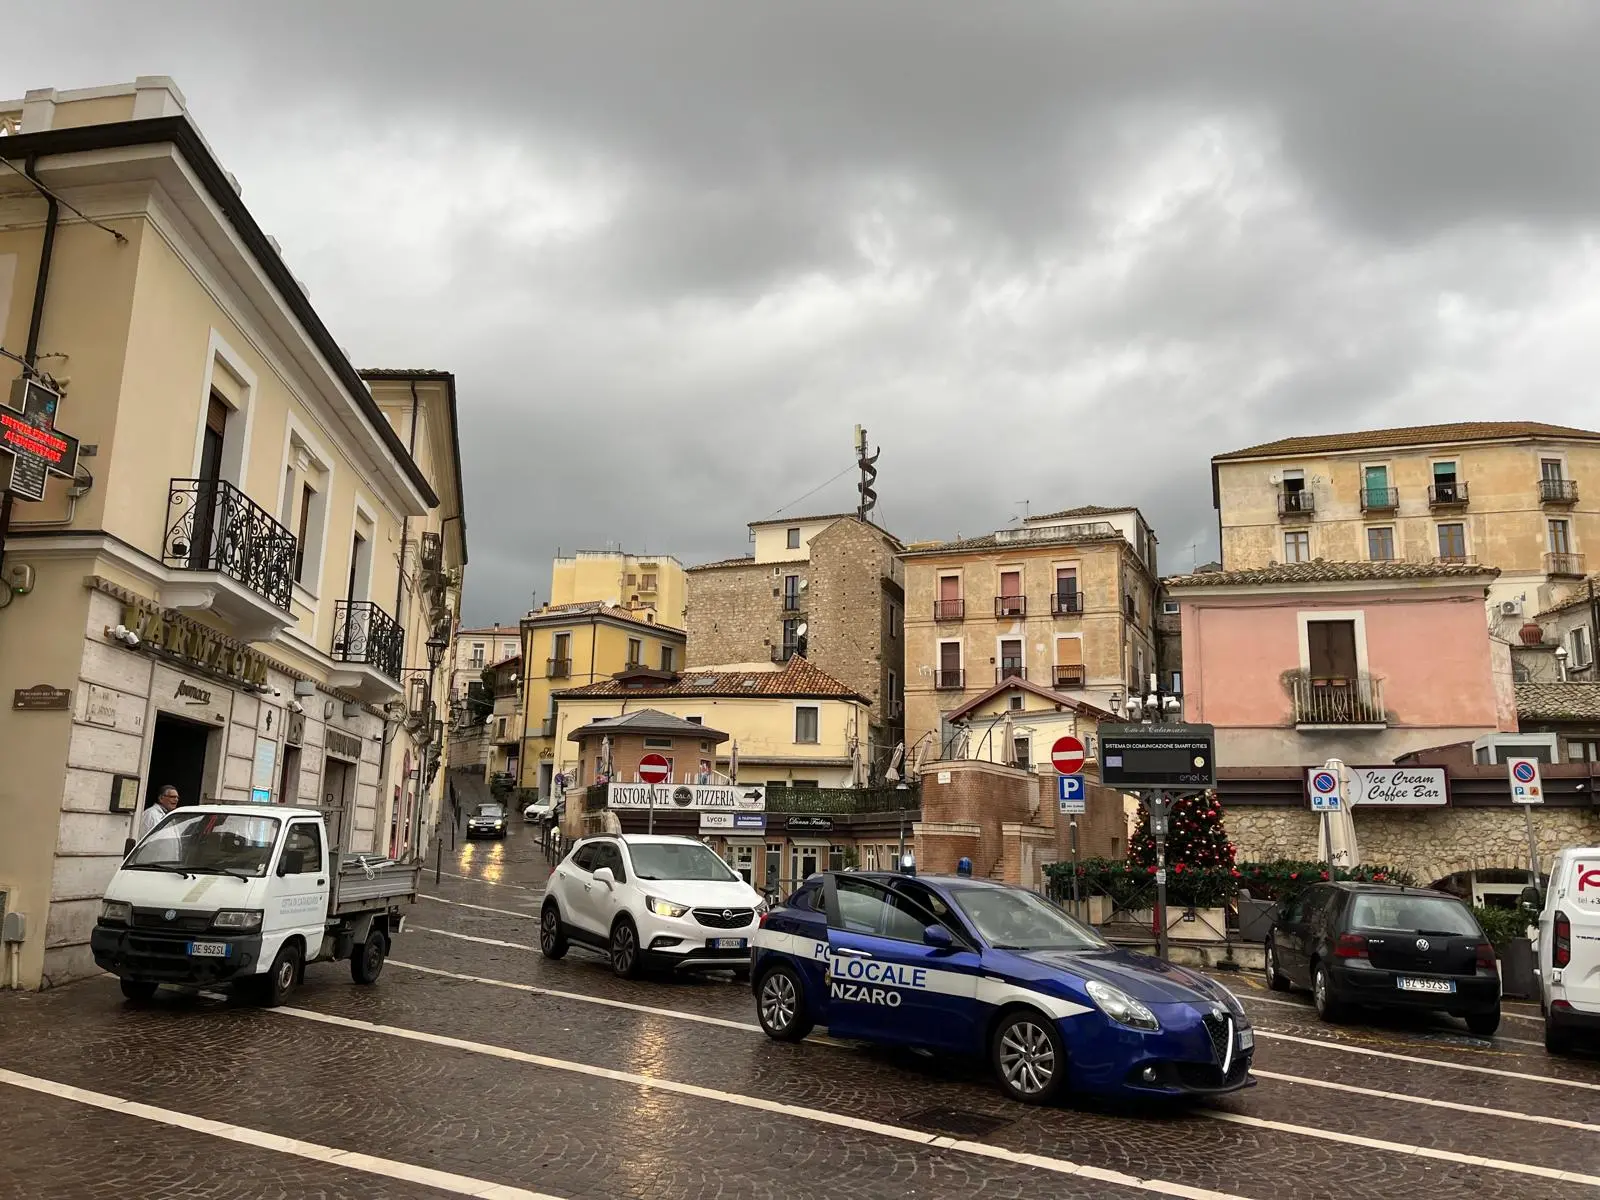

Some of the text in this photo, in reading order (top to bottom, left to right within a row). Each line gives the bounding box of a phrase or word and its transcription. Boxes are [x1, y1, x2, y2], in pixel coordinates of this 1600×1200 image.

[123, 604, 268, 687] FARMACIA
[1063, 778, 1080, 798] P
[1366, 770, 1435, 786] Ice Cream
[612, 787, 670, 805] RISTORANTE
[696, 789, 735, 807] PIZZERIA
[1367, 784, 1440, 801] Coffee Bar
[833, 958, 927, 988] LOCALE
[830, 982, 902, 1008] NZARO
